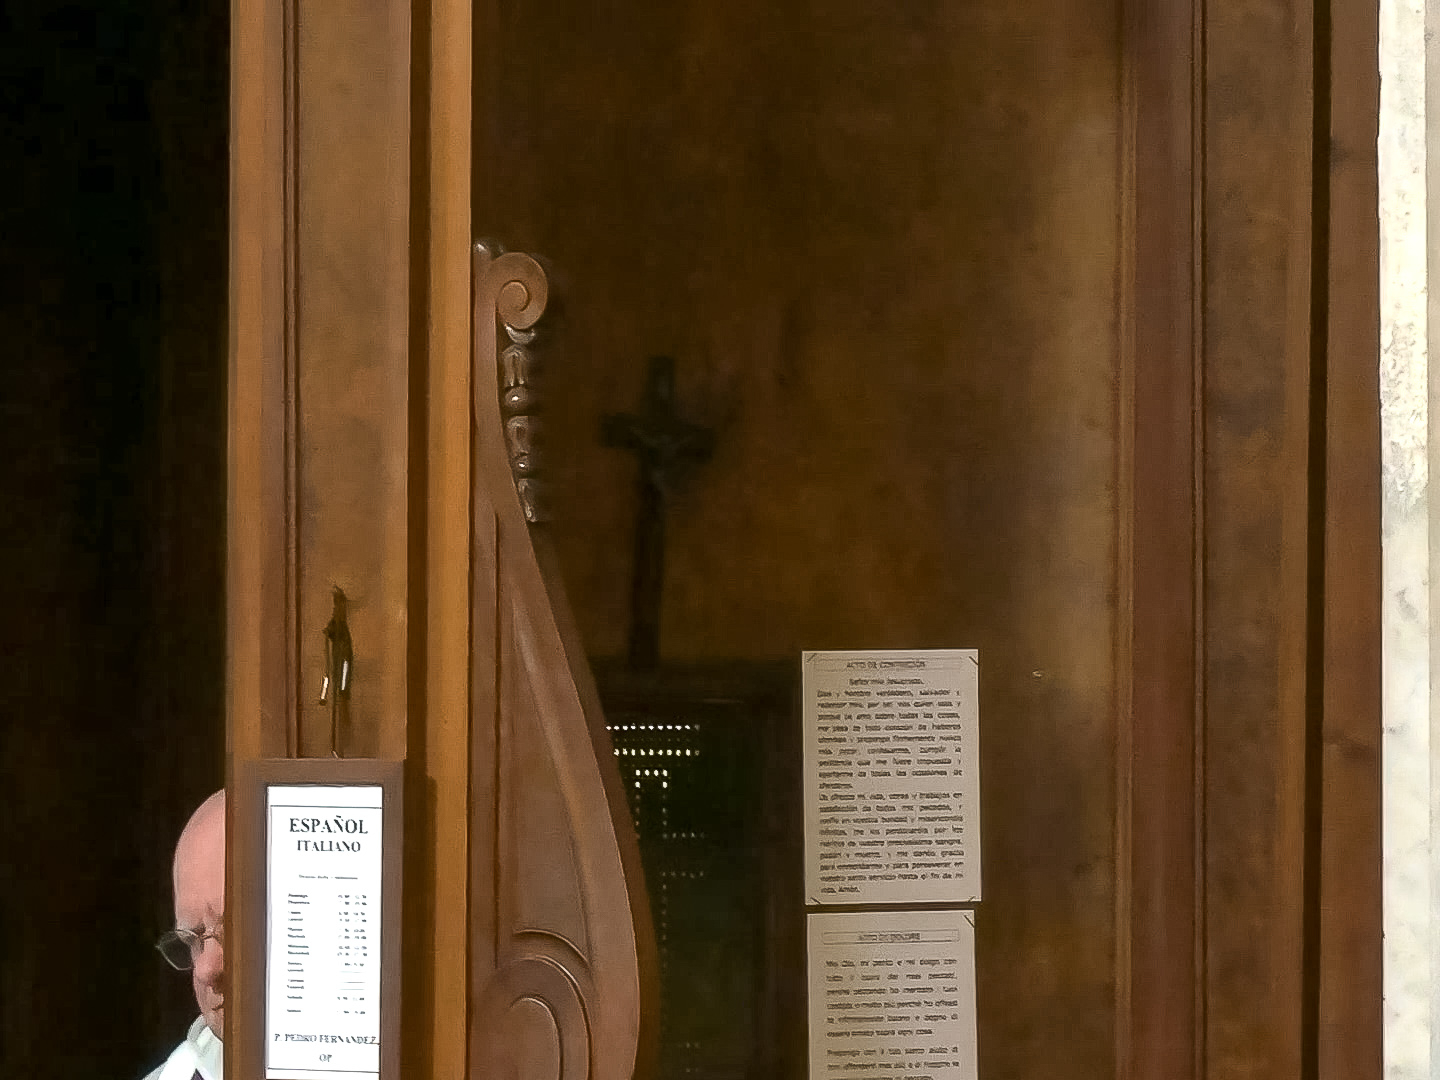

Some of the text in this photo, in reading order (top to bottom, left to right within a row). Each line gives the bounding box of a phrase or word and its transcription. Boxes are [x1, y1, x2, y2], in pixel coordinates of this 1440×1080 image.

[290, 815, 368, 834] ESPAÑOL
[297, 840, 361, 852] ITALIANO
[285, 1034, 317, 1042] PEDRO
